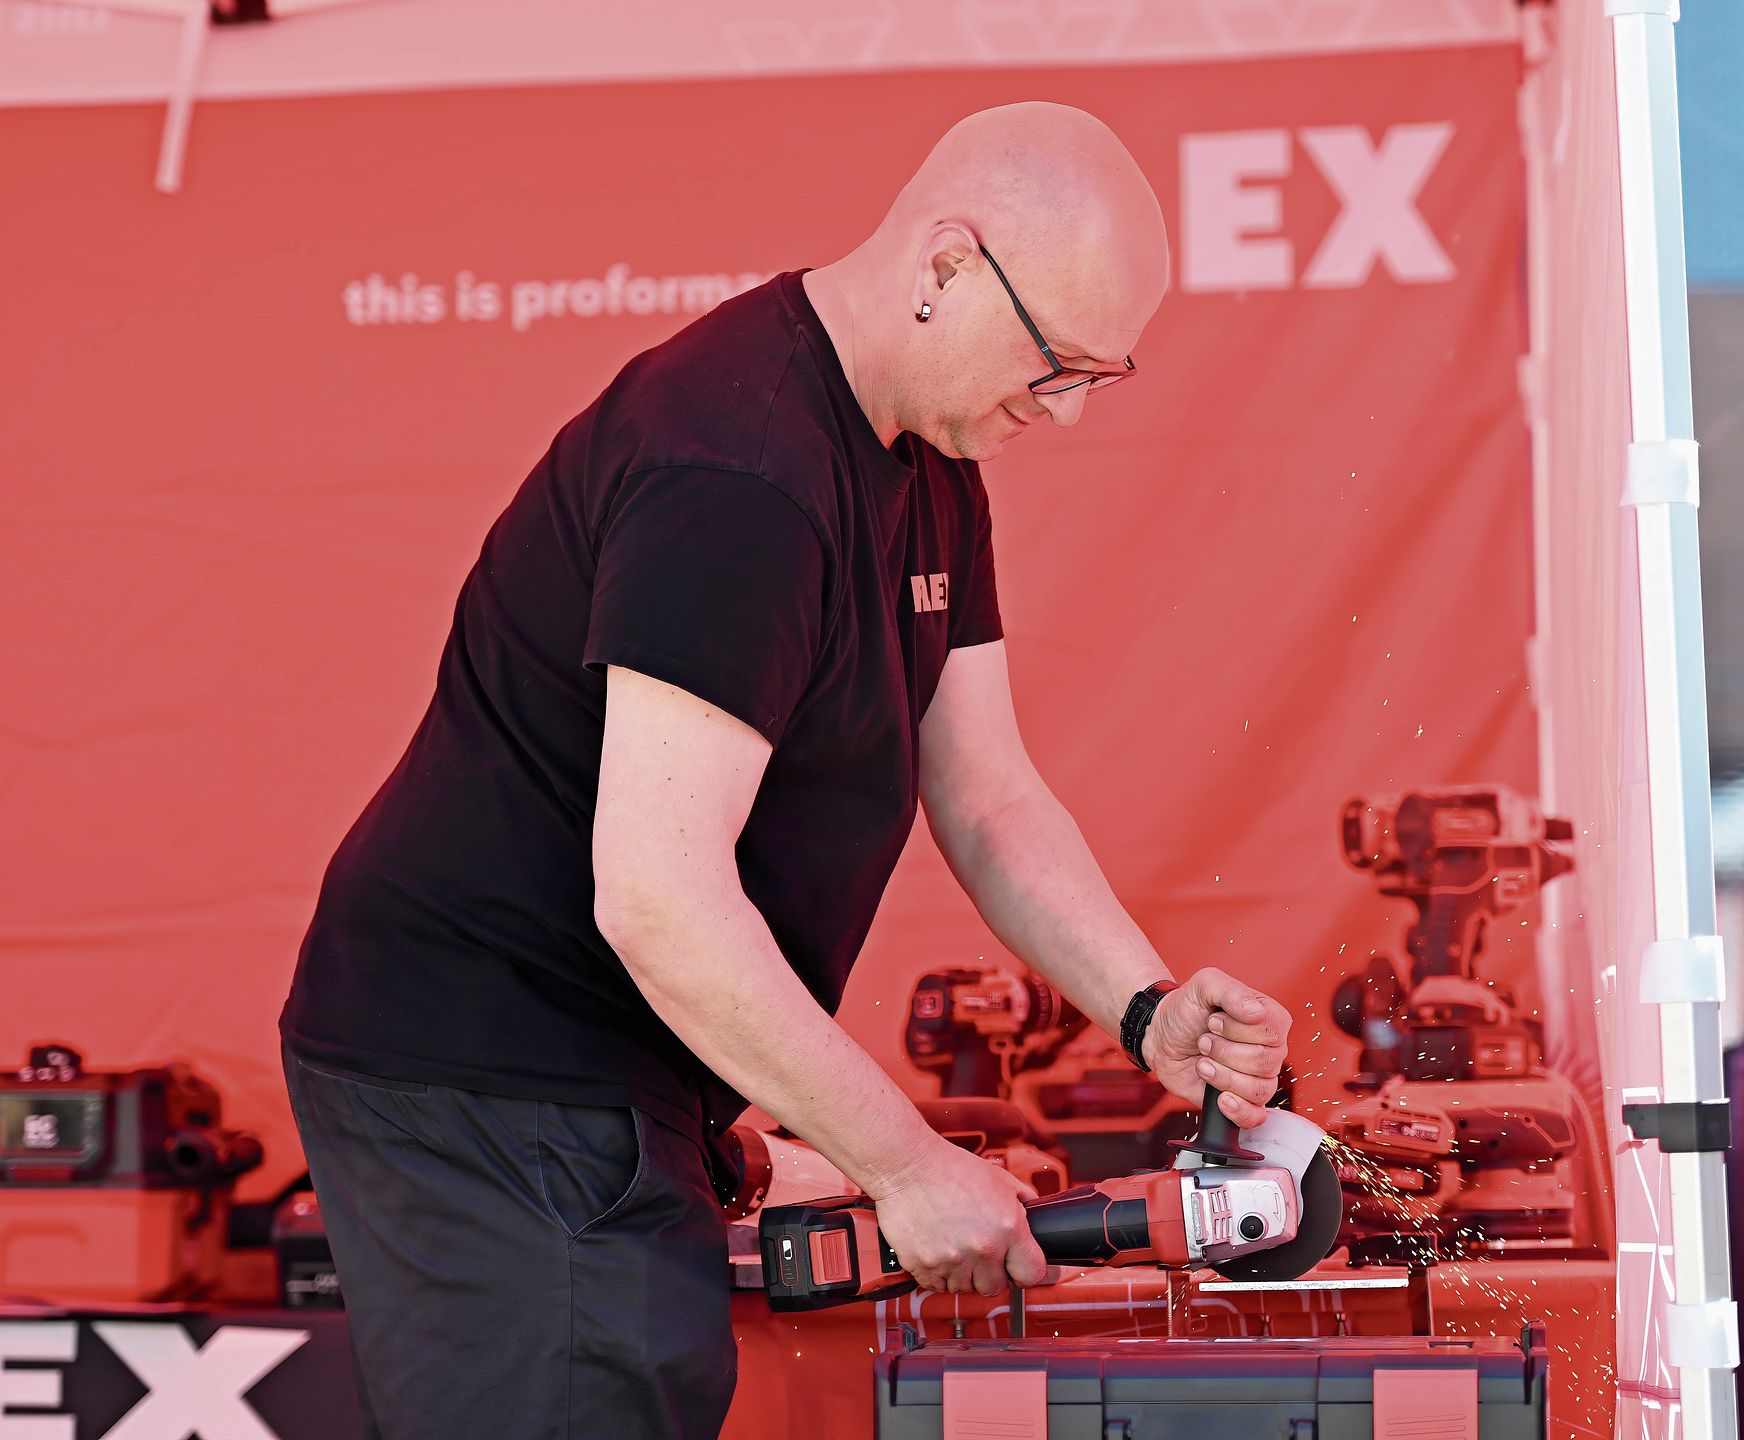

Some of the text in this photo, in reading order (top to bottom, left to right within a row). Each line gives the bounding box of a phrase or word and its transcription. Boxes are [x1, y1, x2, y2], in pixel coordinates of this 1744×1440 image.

[1169, 121, 1457, 293] EX
[345, 264, 779, 332] this is proform
